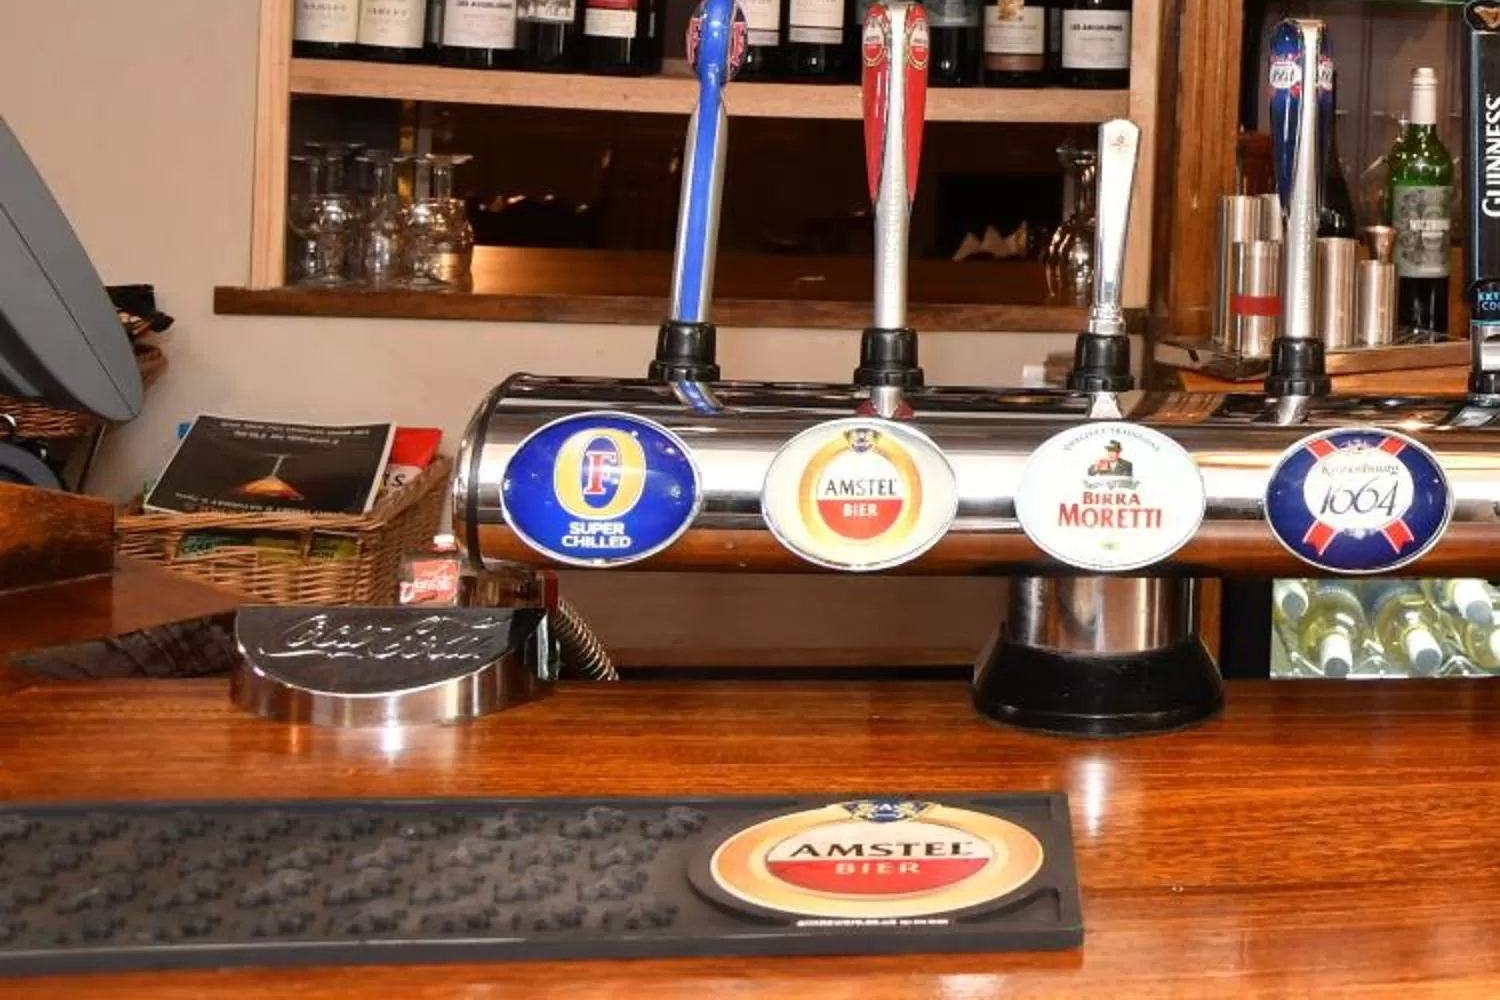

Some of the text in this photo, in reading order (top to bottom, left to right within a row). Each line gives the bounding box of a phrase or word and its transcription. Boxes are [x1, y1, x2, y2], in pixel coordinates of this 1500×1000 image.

[825, 479, 898, 498] AMSTEL
[1083, 491, 1141, 505] BIRRA
[1320, 476, 1399, 517] 1664
[843, 503, 879, 518] BIER
[1058, 503, 1162, 529] MORETTI
[569, 522, 625, 535] SUPER
[562, 535, 632, 549] CHILLED
[789, 842, 973, 858] AMSTEL
[835, 861, 921, 876] BIER
